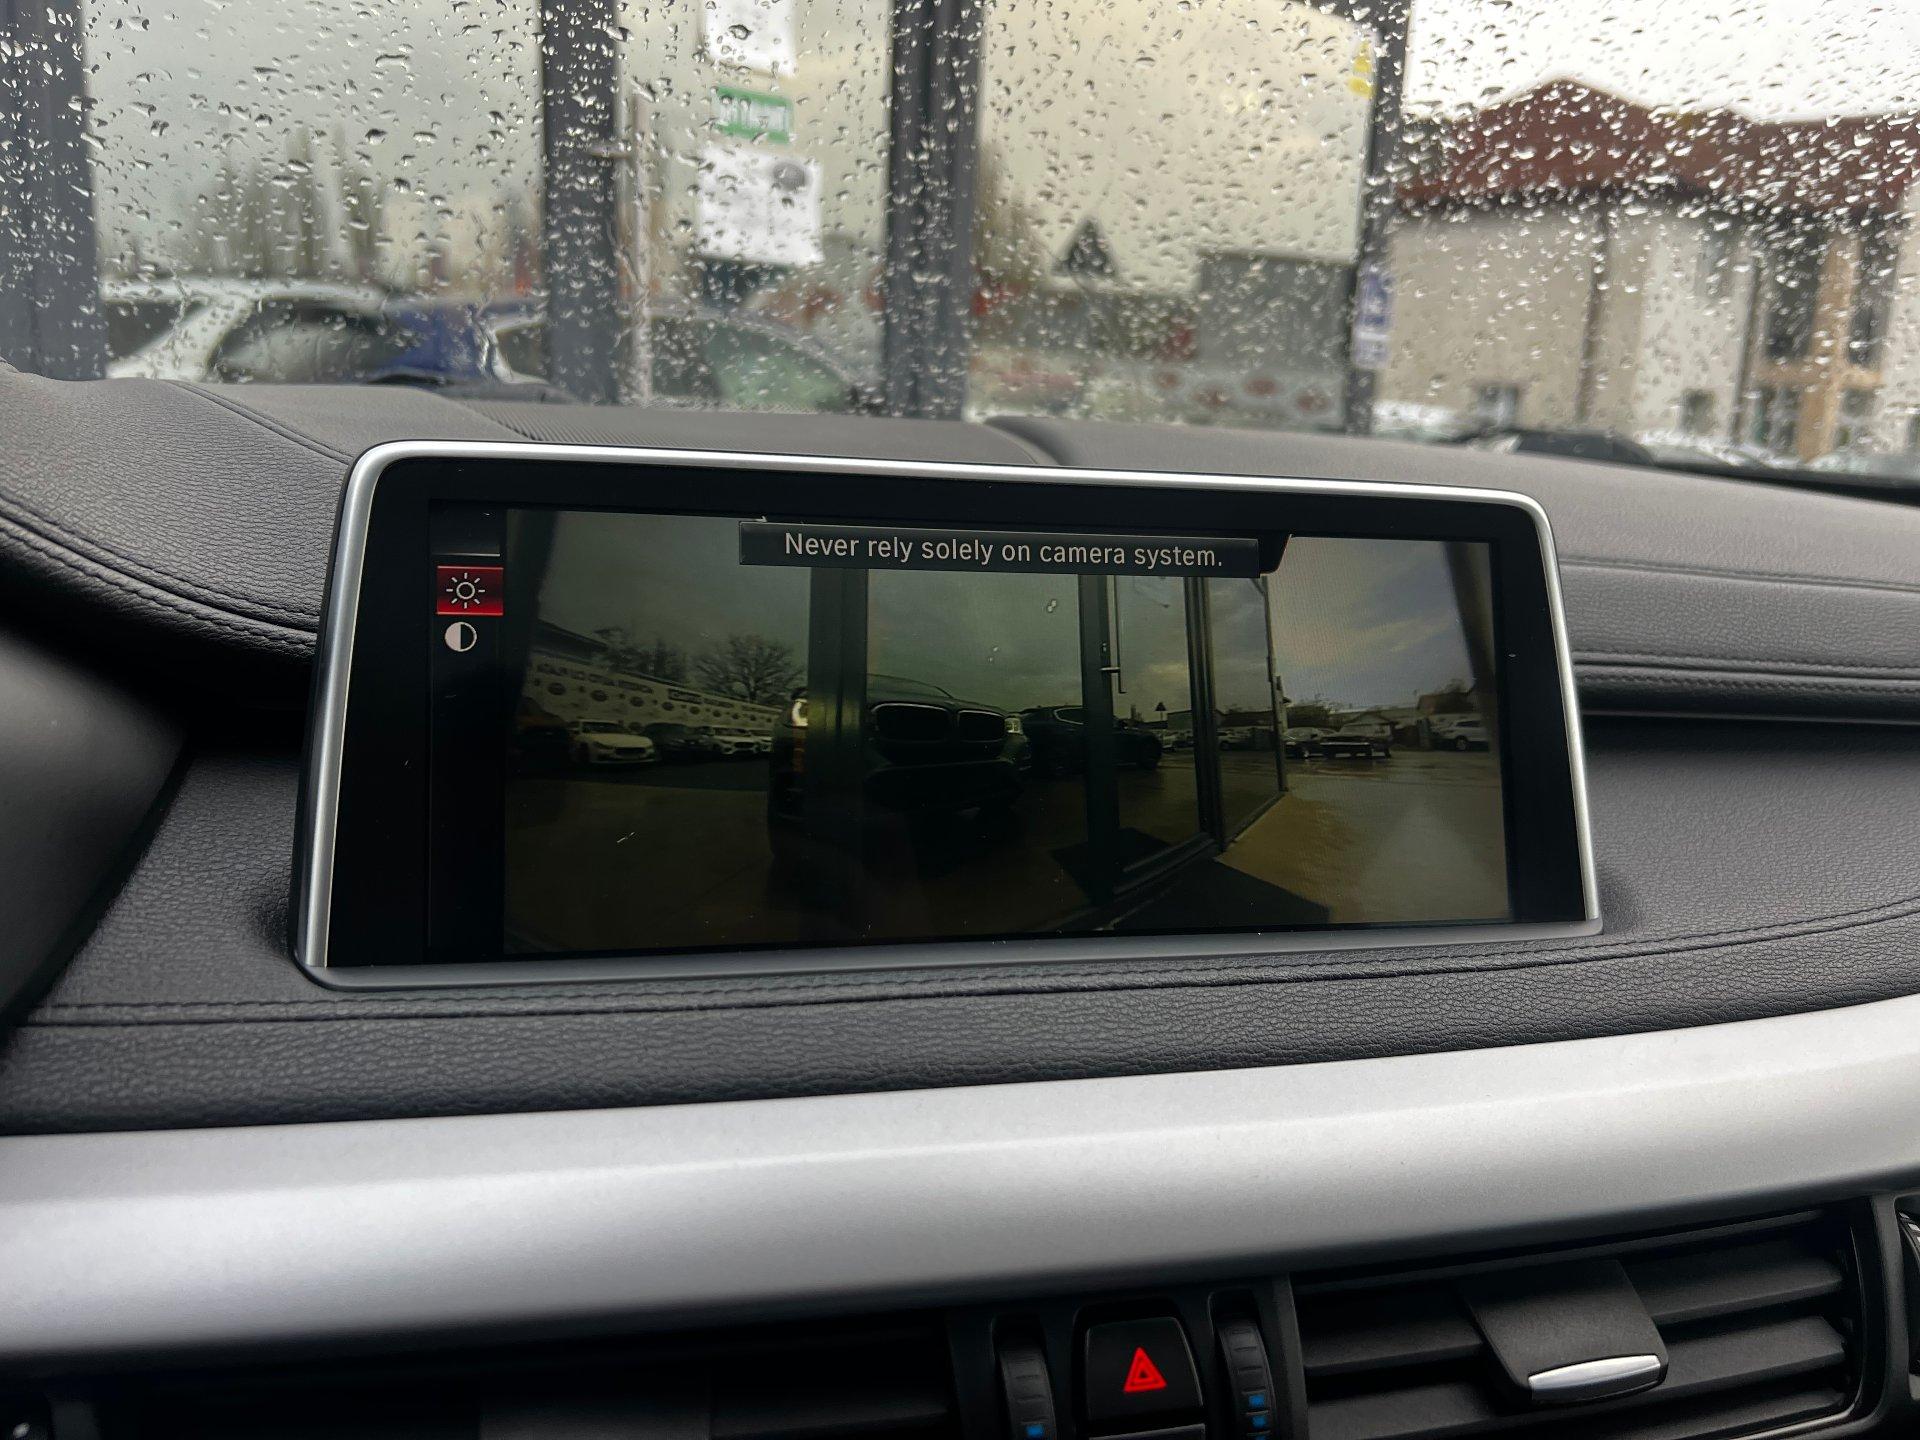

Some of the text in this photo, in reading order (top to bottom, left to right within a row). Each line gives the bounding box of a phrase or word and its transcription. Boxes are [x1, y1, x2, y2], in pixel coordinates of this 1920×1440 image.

[785, 532, 1223, 570] Never rely solely on camera system.
